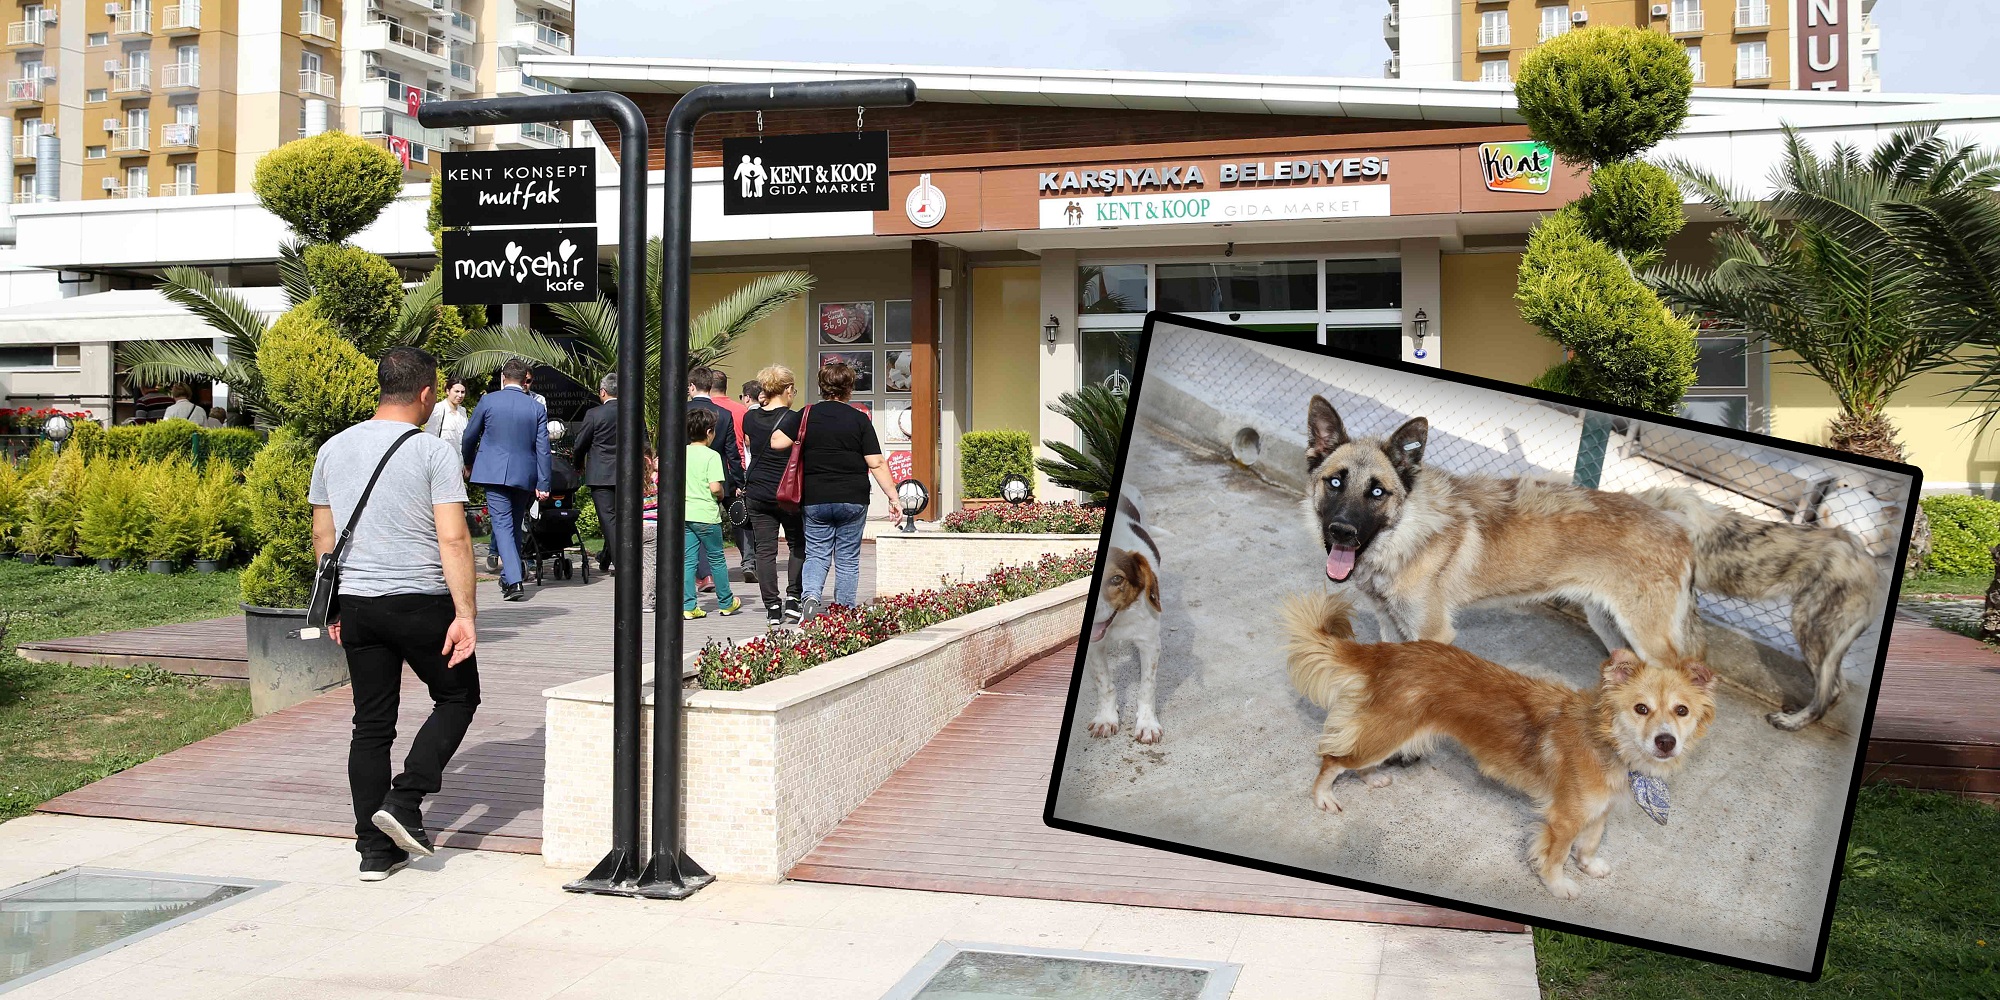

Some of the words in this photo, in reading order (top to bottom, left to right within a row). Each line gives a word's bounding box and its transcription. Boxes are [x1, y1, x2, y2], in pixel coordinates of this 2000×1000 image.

[1808, 0, 1839, 91] NU
[448, 168, 492, 181] KENT
[504, 165, 587, 179] KONSEPT
[769, 165, 814, 185] KENT
[830, 162, 877, 183] KOOP
[1484, 146, 1548, 183] Kent
[769, 185, 808, 195] GIDA
[816, 182, 876, 195] MARKET
[1039, 165, 1204, 193] KARŞIYAKA
[479, 180, 561, 210] mutfak
[1096, 201, 1143, 221] KENT
[1145, 200, 1159, 219] &
[1162, 198, 1211, 219] KOOP
[1224, 205, 1273, 217] GIDA
[1284, 200, 1360, 214] MARKET
[455, 239, 584, 284] mavişehir
[546, 278, 585, 292] kafe
[823, 317, 848, 331] 36,90
